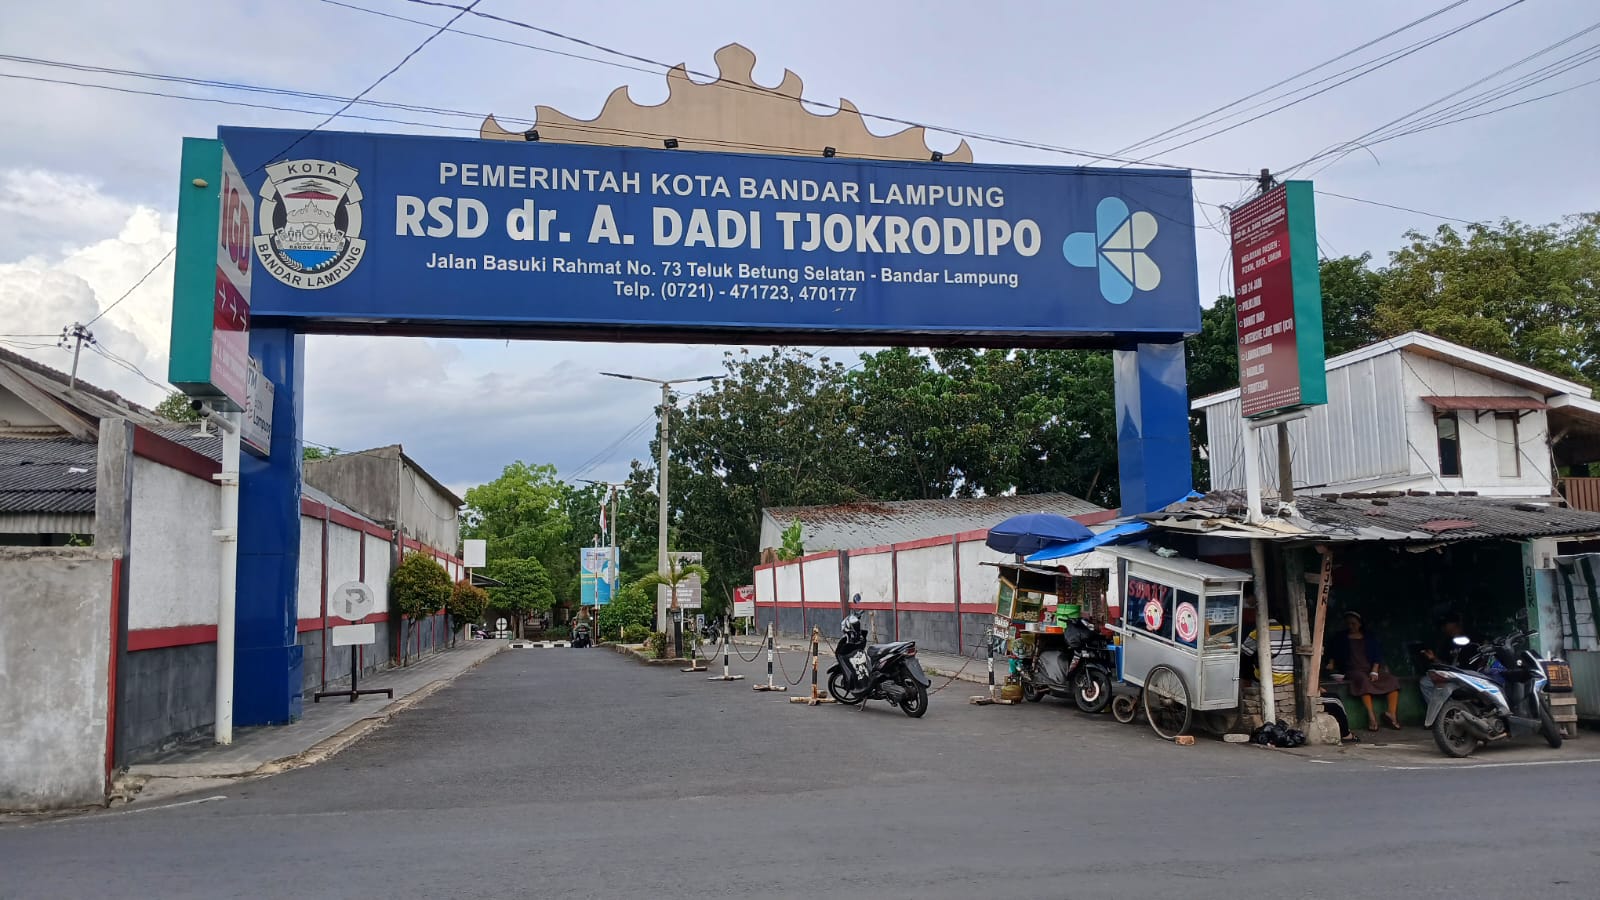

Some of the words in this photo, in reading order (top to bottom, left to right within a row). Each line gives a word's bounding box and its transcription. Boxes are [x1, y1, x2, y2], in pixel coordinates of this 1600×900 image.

[287, 163, 337, 177] KOTA
[439, 162, 640, 194] PEMERINTAH
[651, 173, 731, 198] KOTA
[739, 177, 861, 203] BANDAR
[869, 182, 1005, 208] LAMPUNG
[221, 172, 251, 276] IGD
[395, 195, 489, 239] RSD
[506, 198, 571, 242] dr.
[587, 204, 635, 245] A.
[653, 206, 761, 251] DADI
[775, 211, 1042, 257] TJOKRODIPO
[258, 243, 302, 286] BANDAR
[307, 247, 362, 287] LAMPUNG
[426, 252, 479, 270] Jalan
[483, 254, 546, 272] Basuki
[552, 257, 622, 275] Rahmat
[627, 260, 657, 277] No.
[661, 261, 682, 277] 73
[686, 261, 733, 279] Teluk
[738, 263, 799, 284] Betung
[803, 265, 865, 282] Selatan
[881, 267, 940, 283] Bandar
[944, 269, 1019, 289] Lampung
[613, 280, 657, 301] Telp.
[661, 281, 714, 302] (0721)
[729, 283, 794, 303] 471723,
[798, 285, 857, 302] 470177
[248, 367, 258, 390] TM
